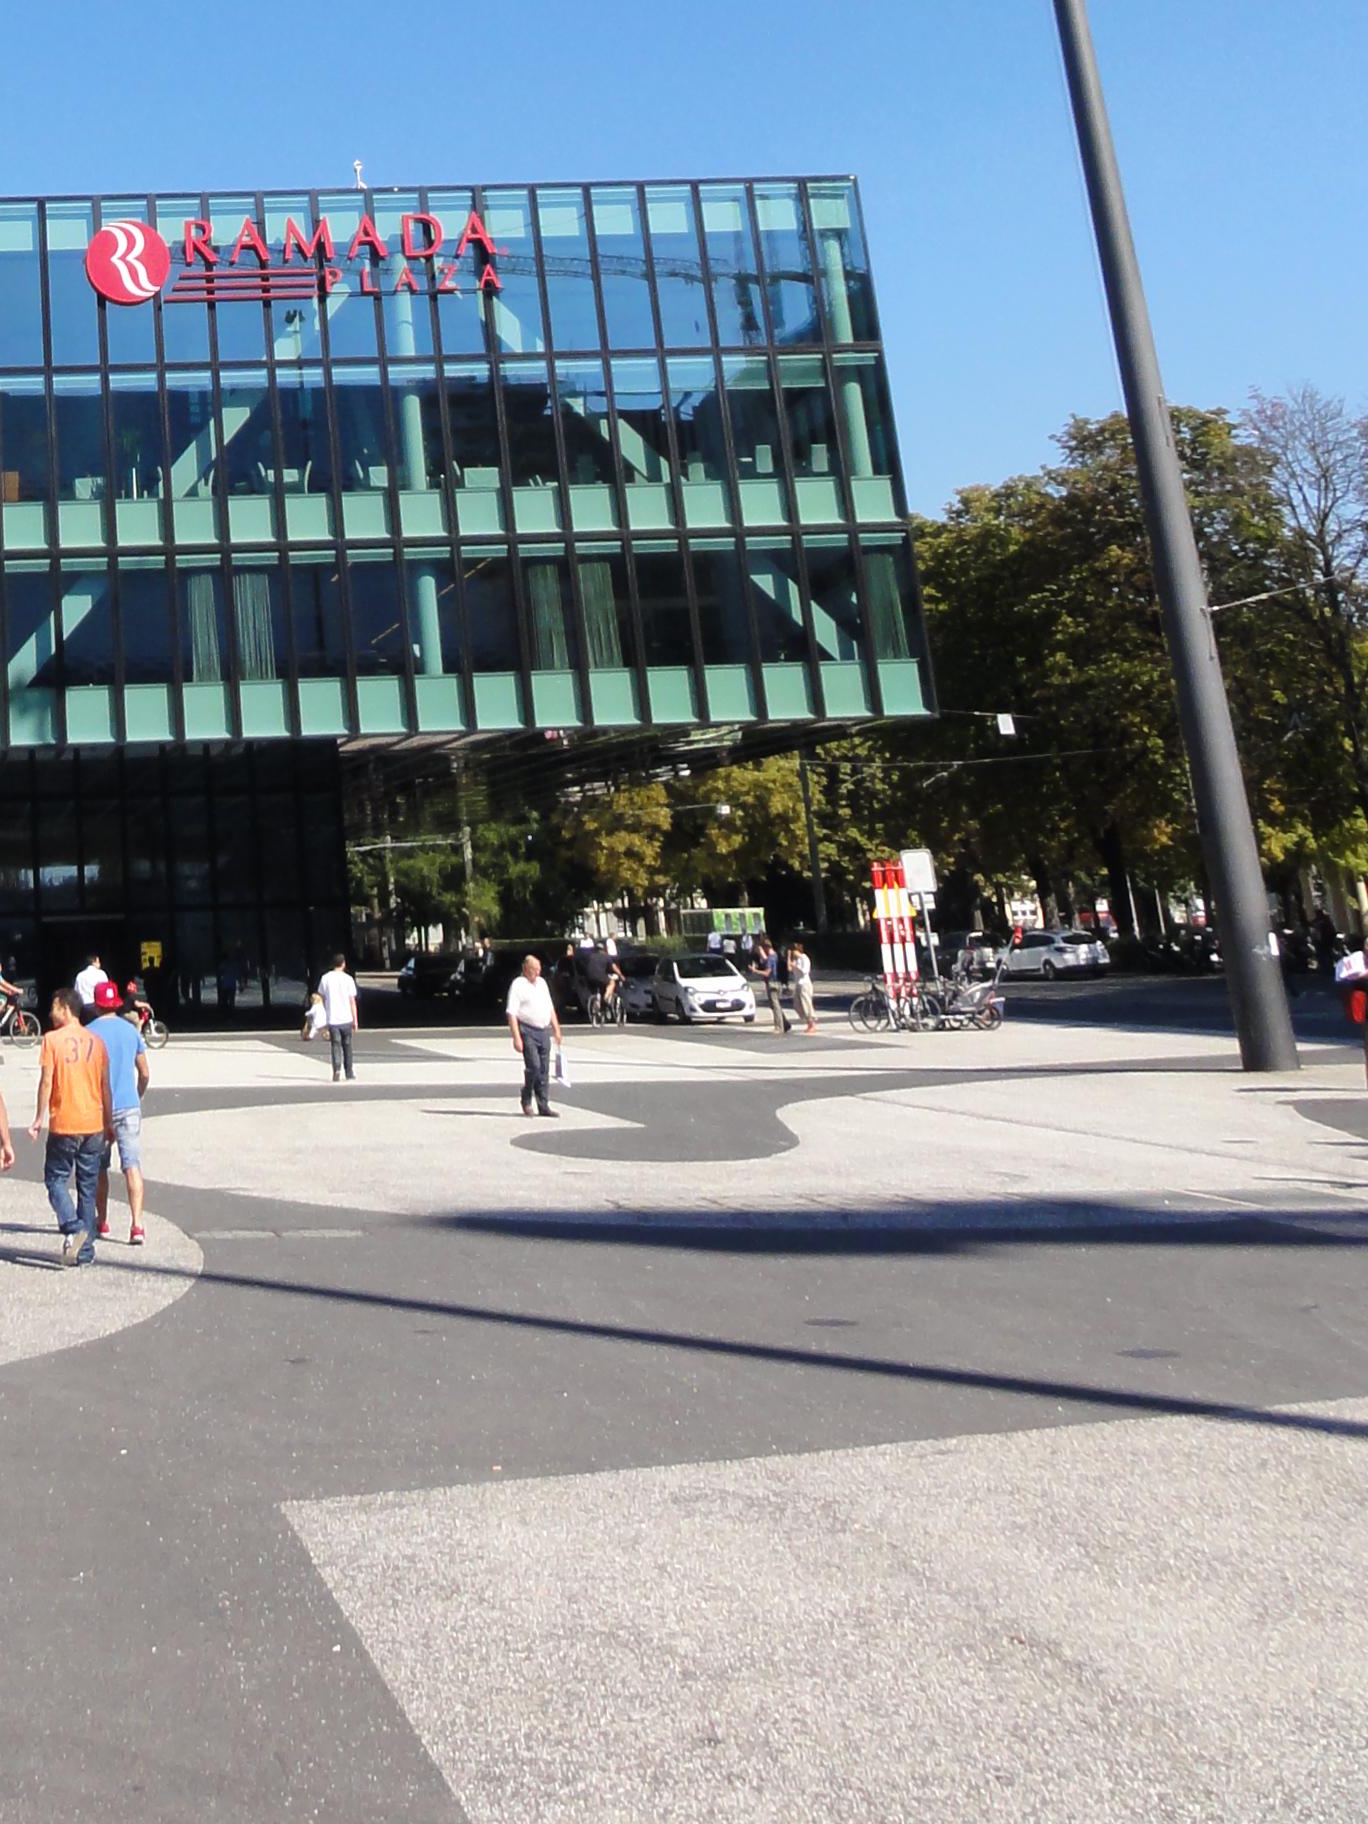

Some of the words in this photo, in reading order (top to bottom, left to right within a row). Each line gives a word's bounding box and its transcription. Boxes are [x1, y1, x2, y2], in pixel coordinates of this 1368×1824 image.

[184, 211, 497, 265] RAMADA
[325, 263, 504, 294] PLAZA
[64, 1037, 94, 1063] 37
